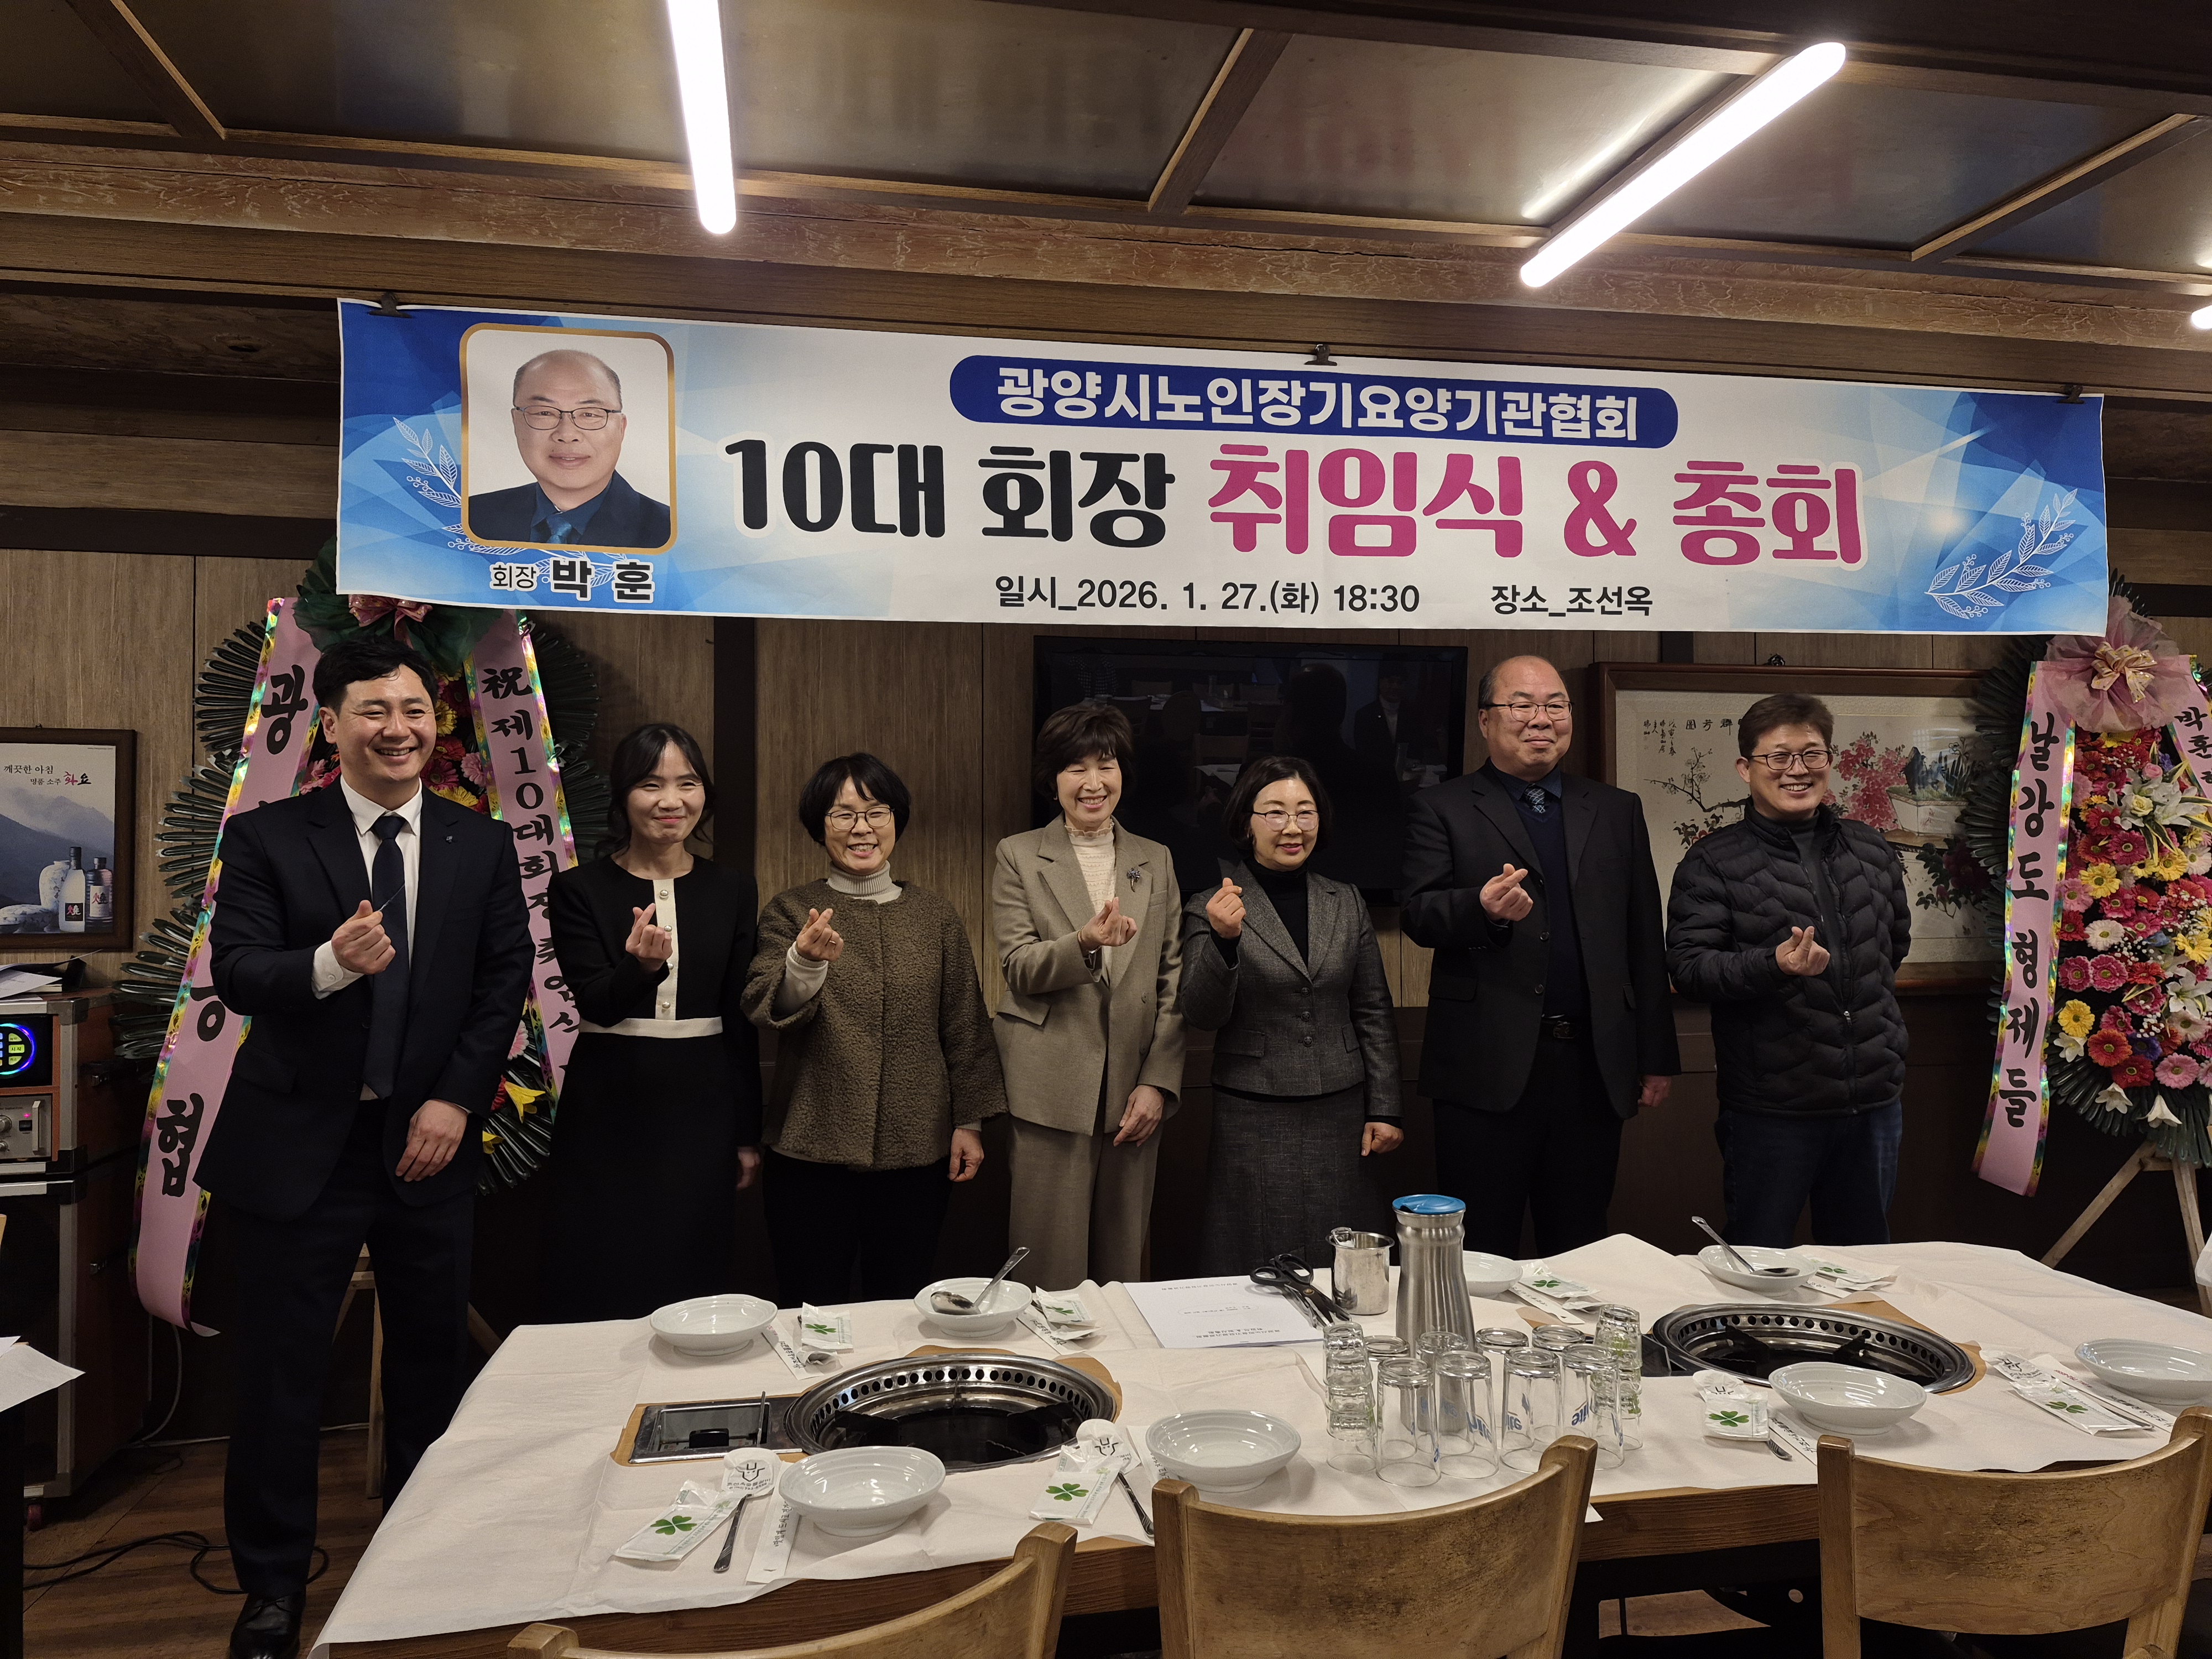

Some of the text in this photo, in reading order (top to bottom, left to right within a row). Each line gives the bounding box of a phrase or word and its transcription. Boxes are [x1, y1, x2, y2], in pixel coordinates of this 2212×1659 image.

[997, 367, 1638, 441] 광양시노인장기요양기관협회
[725, 440, 1862, 566] 10대 회장 취임식 & 총회
[492, 560, 652, 600] 회장 박 훈
[1183, 582, 1207, 611] 1.
[1334, 585, 1420, 612] 18:30
[1490, 585, 1653, 617] 장소_조선옥
[3, 765, 53, 774] 깨끗한 아침
[64, 771, 92, 786] 화요
